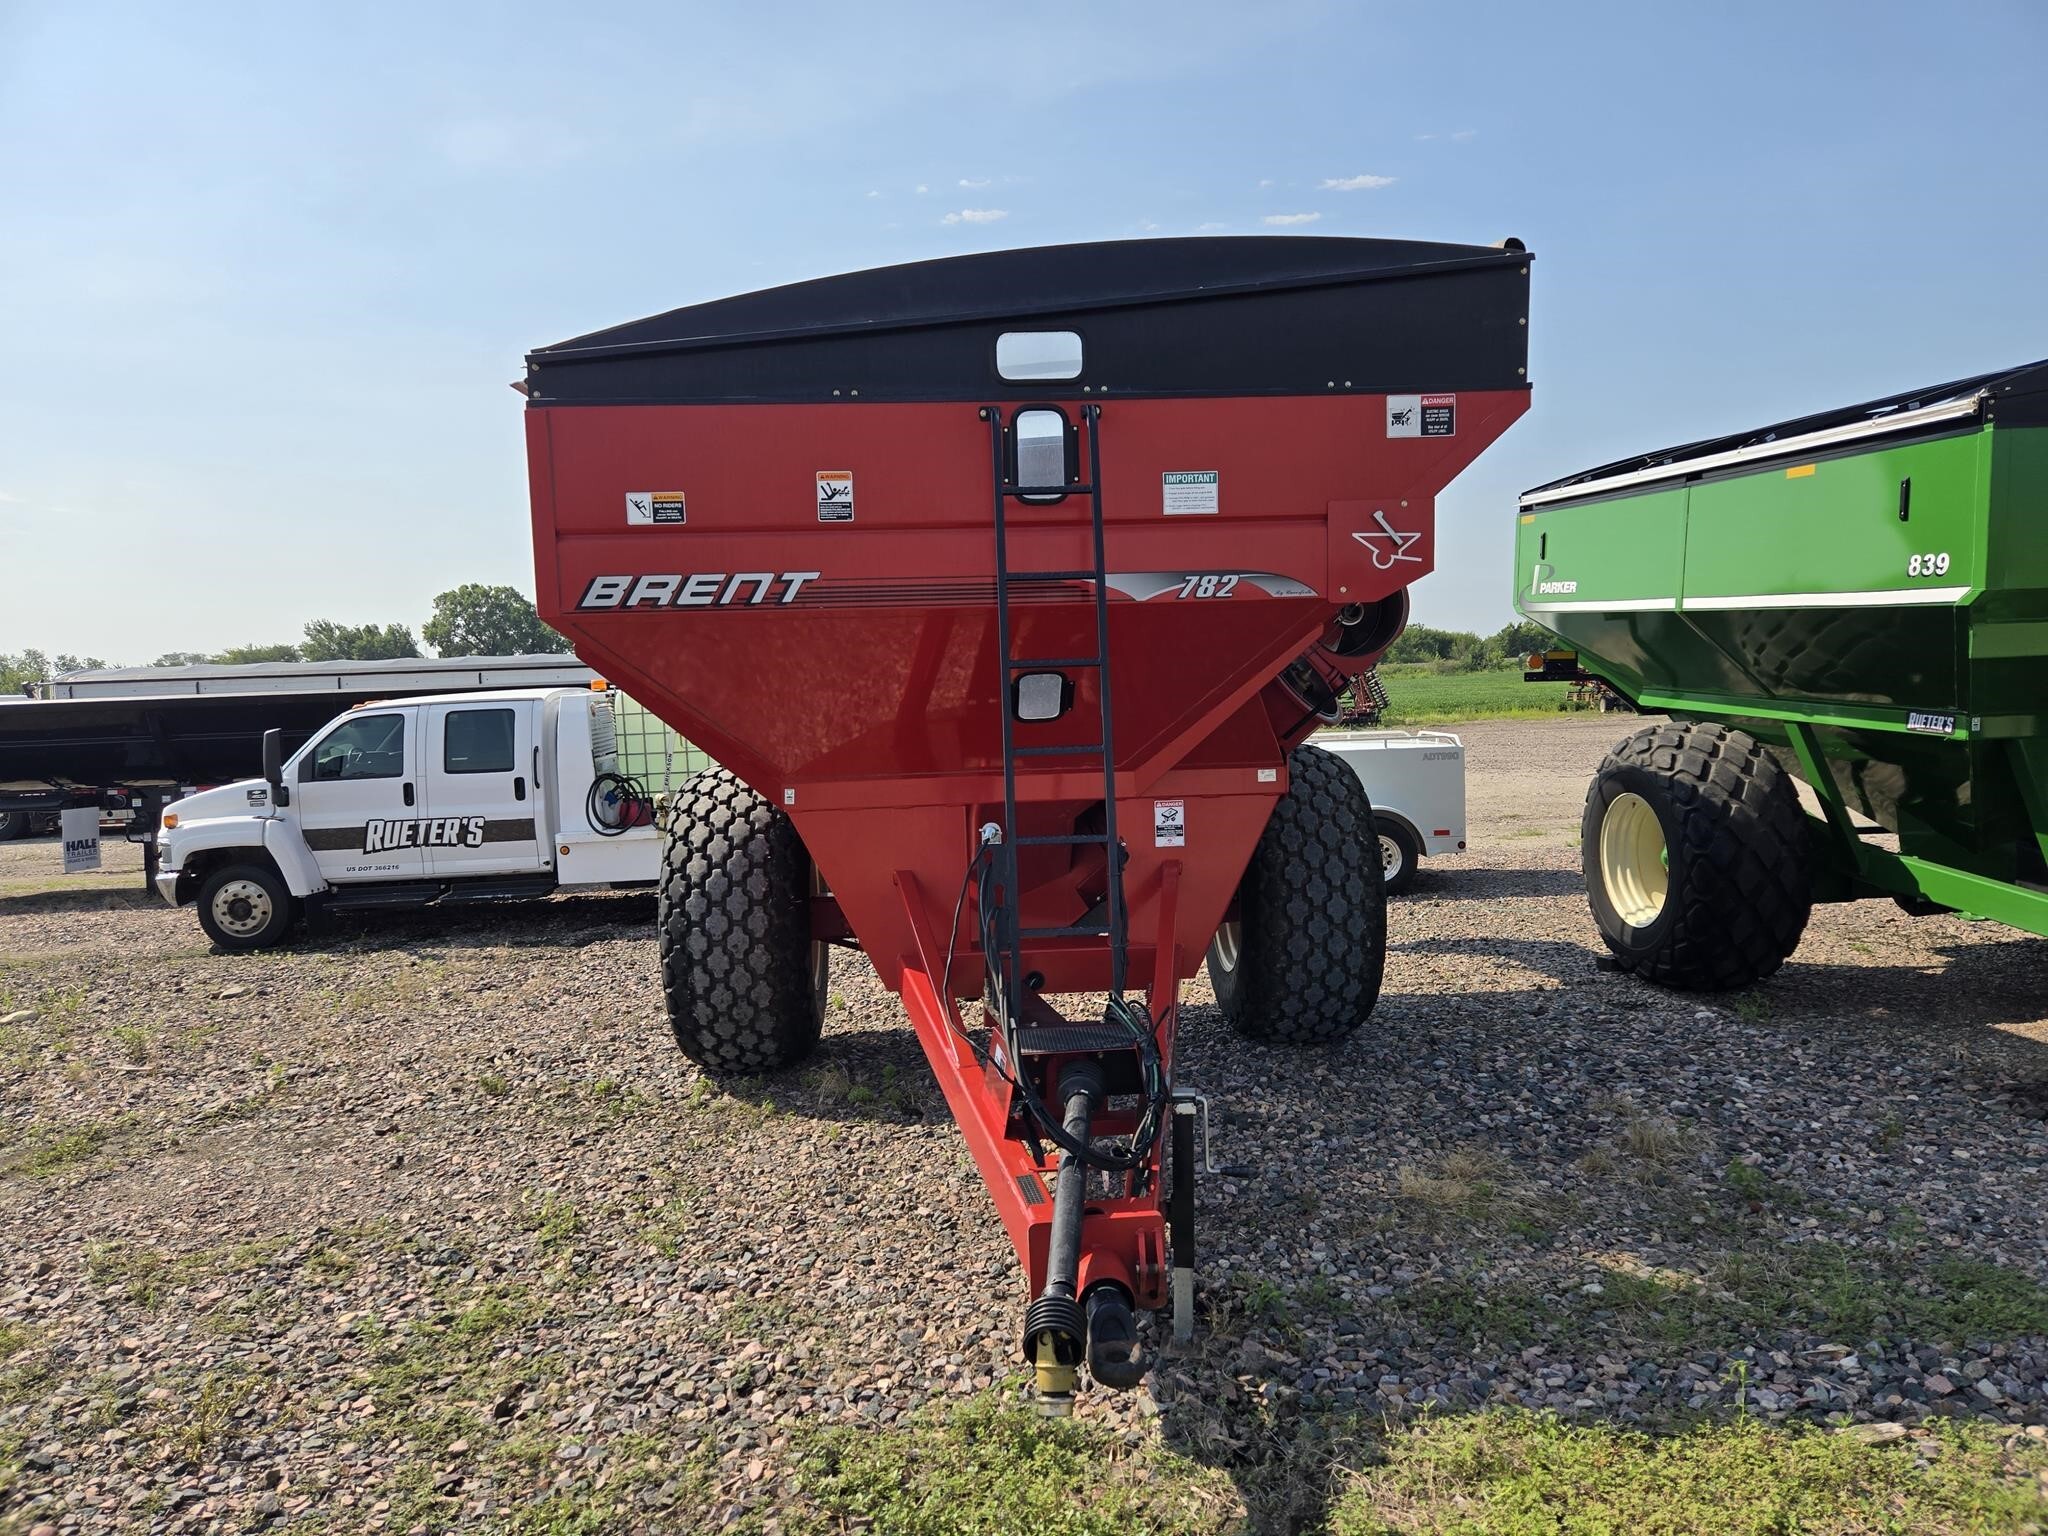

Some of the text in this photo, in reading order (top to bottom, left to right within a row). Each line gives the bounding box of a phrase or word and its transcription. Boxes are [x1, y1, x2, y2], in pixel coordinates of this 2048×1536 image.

[1165, 473, 1215, 483] IMPORTANT
[1907, 552, 1950, 577] 839
[576, 571, 821, 609] BRENT
[1177, 574, 1240, 599] 782
[1539, 581, 1577, 594] PARKER
[1907, 712, 1955, 733] RUETER'S
[66, 838, 97, 852] HALE
[363, 816, 486, 855] RUETER'S
[66, 849, 97, 858] TRAILER
